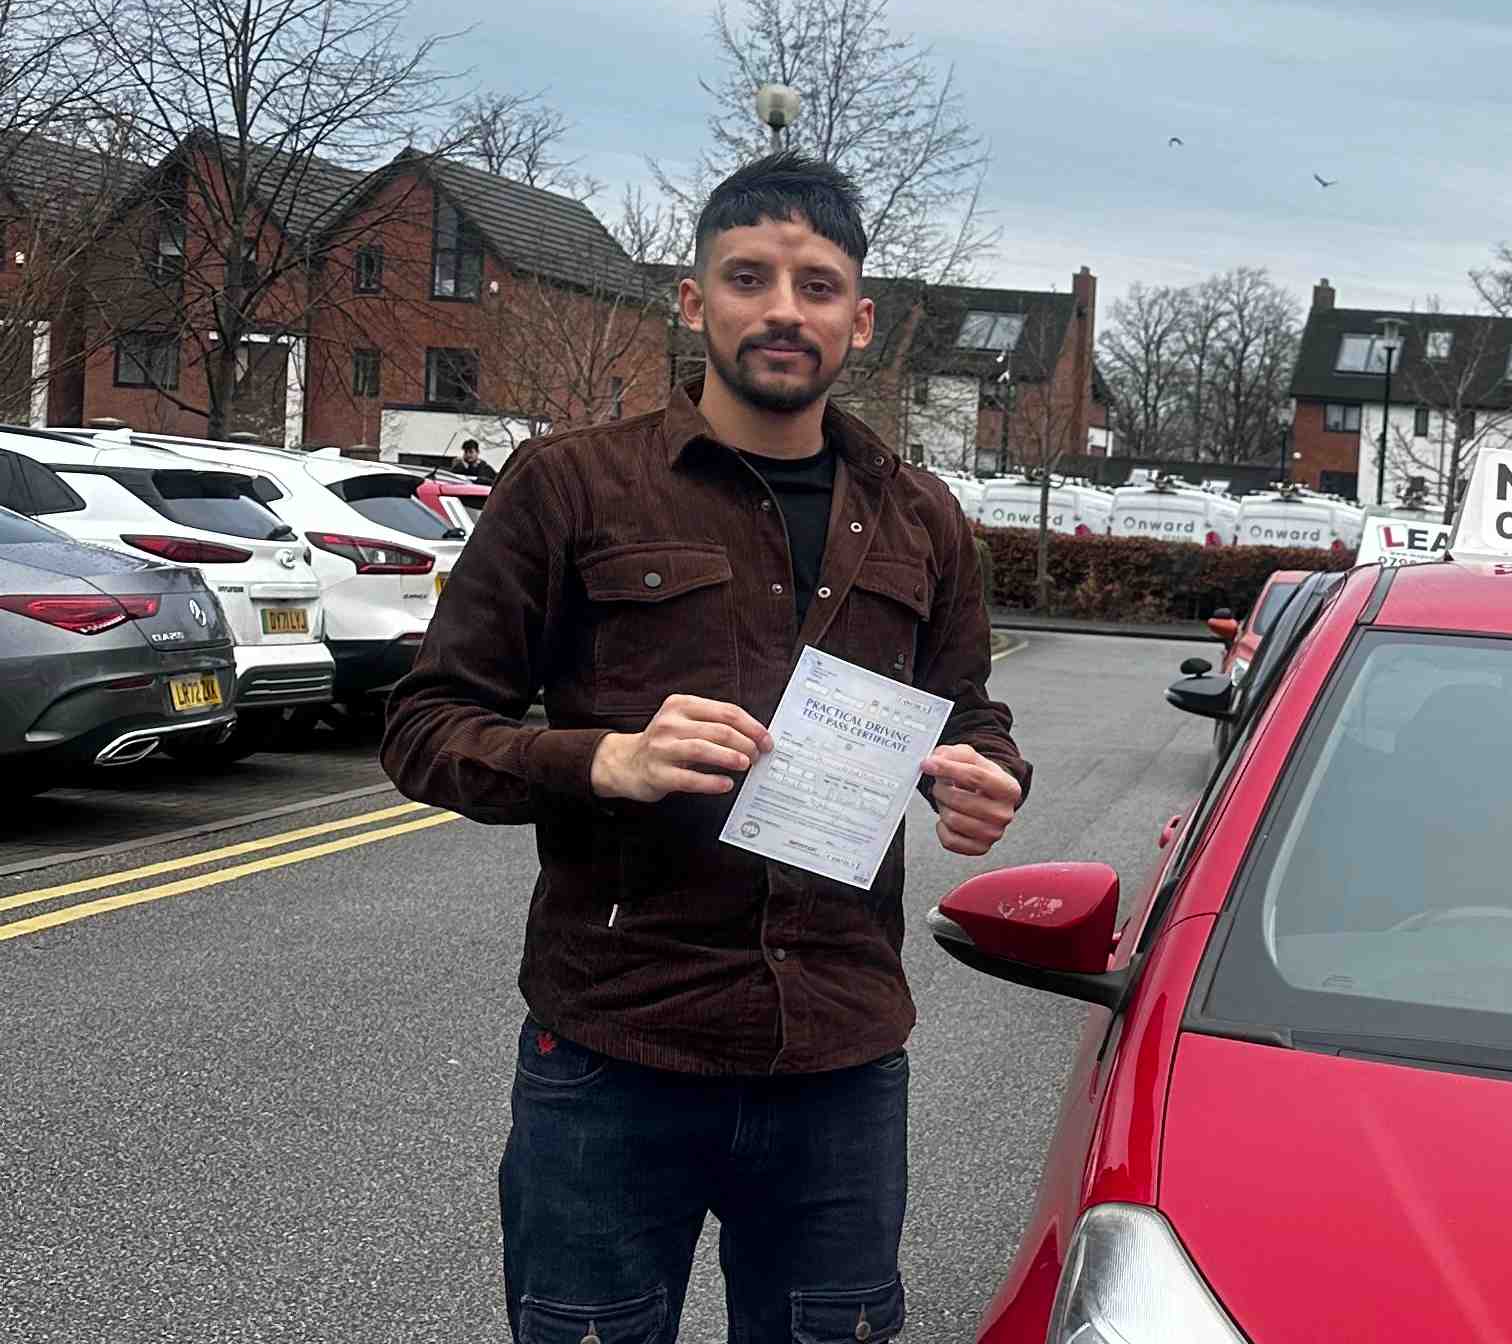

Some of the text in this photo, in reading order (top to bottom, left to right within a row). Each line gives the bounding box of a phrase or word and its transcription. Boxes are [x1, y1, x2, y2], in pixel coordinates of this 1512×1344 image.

[1123, 516, 1195, 534] Onward
[1250, 525, 1321, 543] Onward
[806, 697, 862, 727] PRACTICAL
[865, 720, 912, 745] DRIVING
